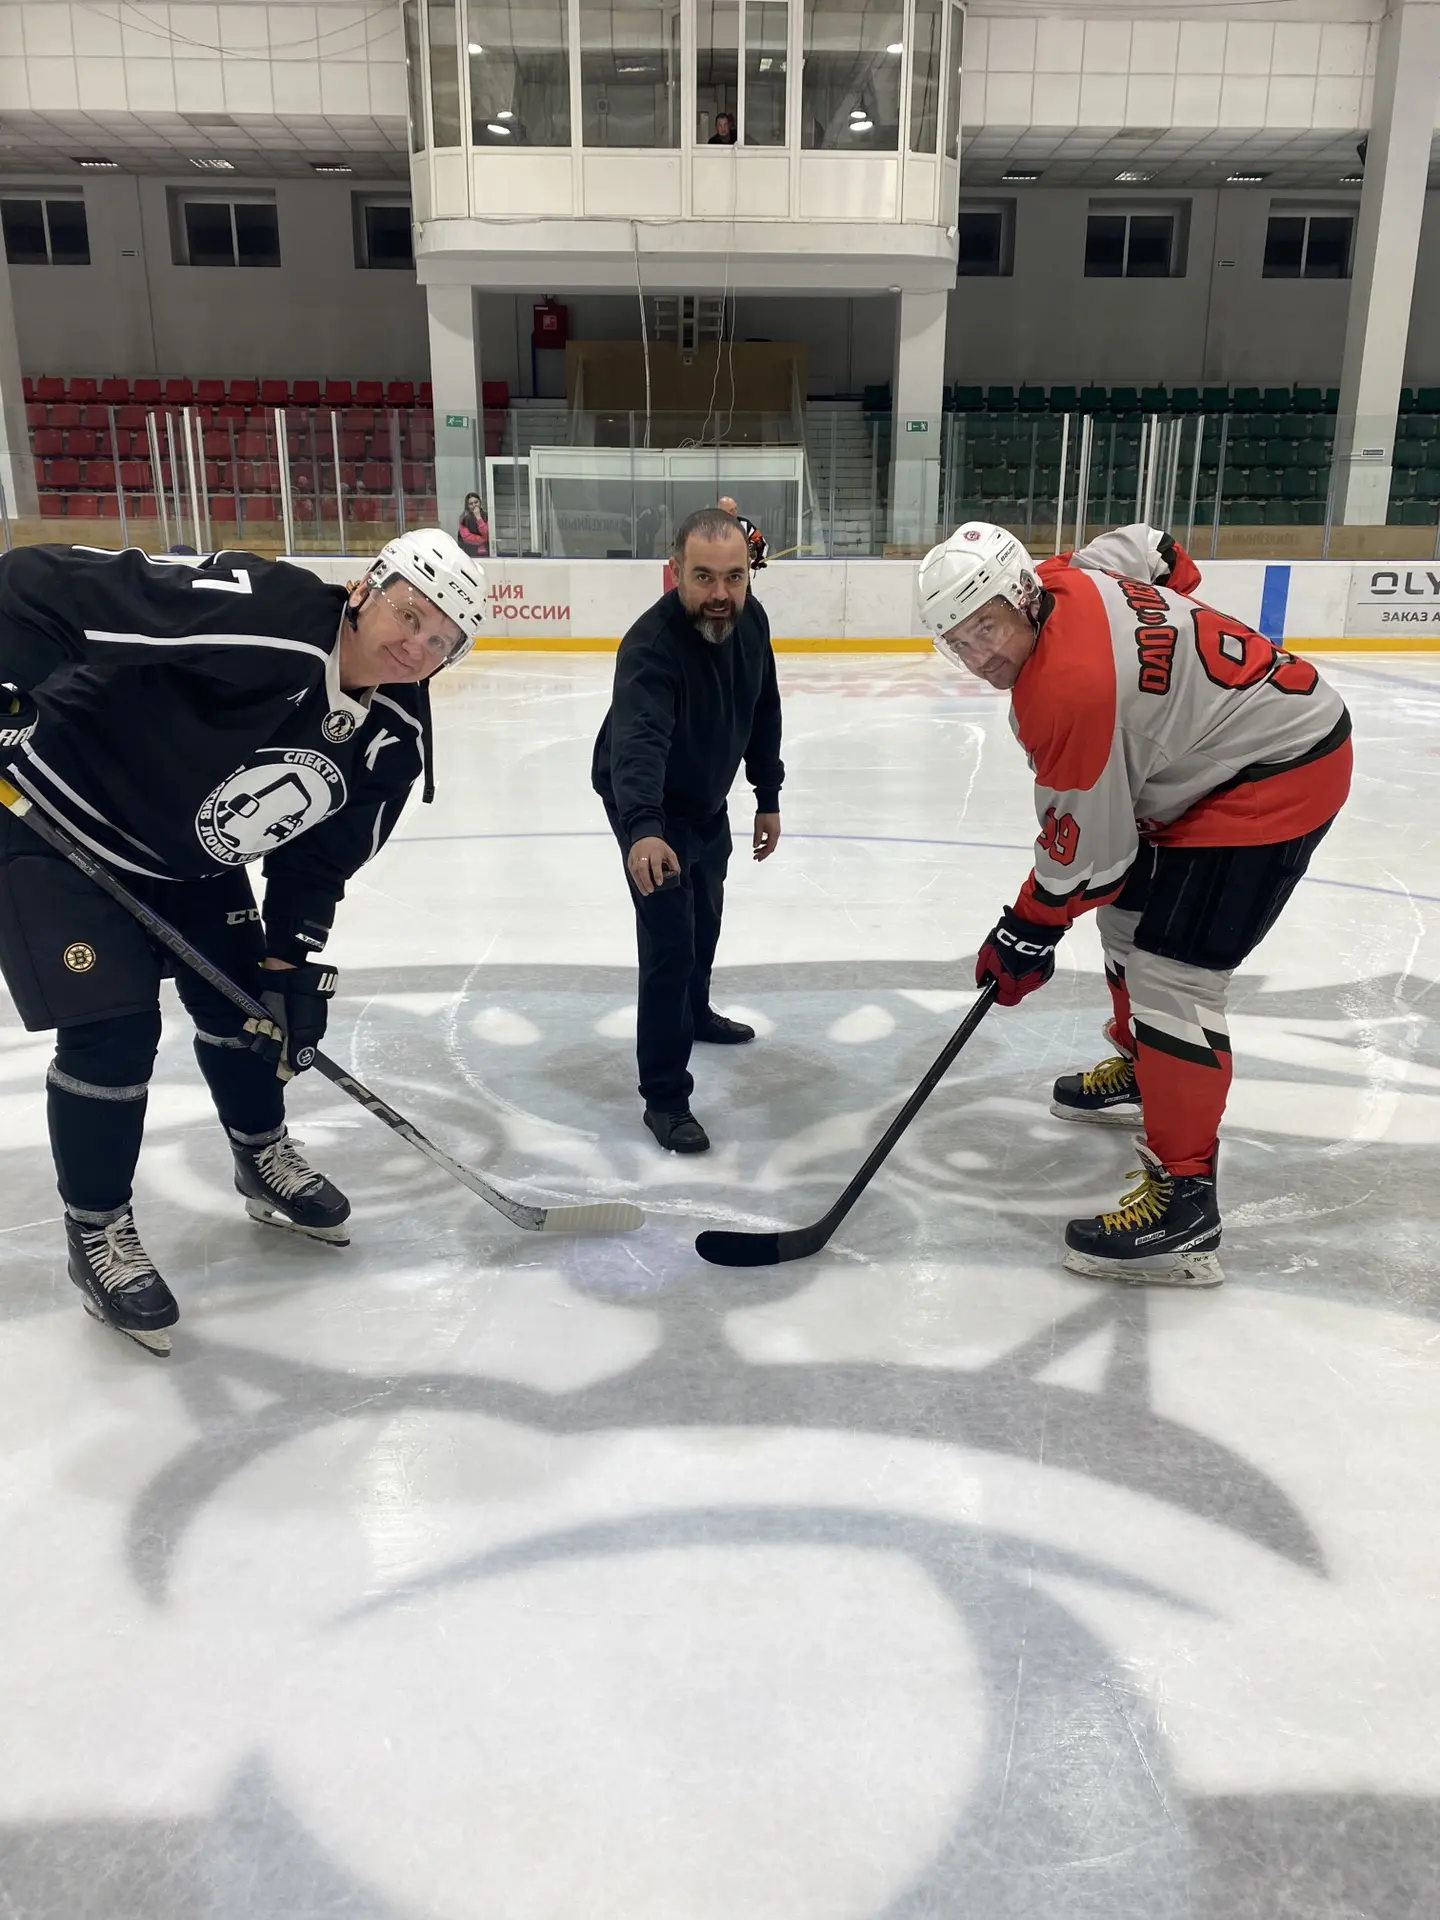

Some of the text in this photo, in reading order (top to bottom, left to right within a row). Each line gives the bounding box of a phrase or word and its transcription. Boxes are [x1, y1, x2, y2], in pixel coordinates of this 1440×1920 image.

[448, 581, 474, 605] CCM
[492, 604, 570, 621] РОССИИ
[1381, 611, 1429, 622] ЗАКАЗ
[283, 751, 338, 785] СПЕКТР
[200, 825, 235, 862] ЛОМА
